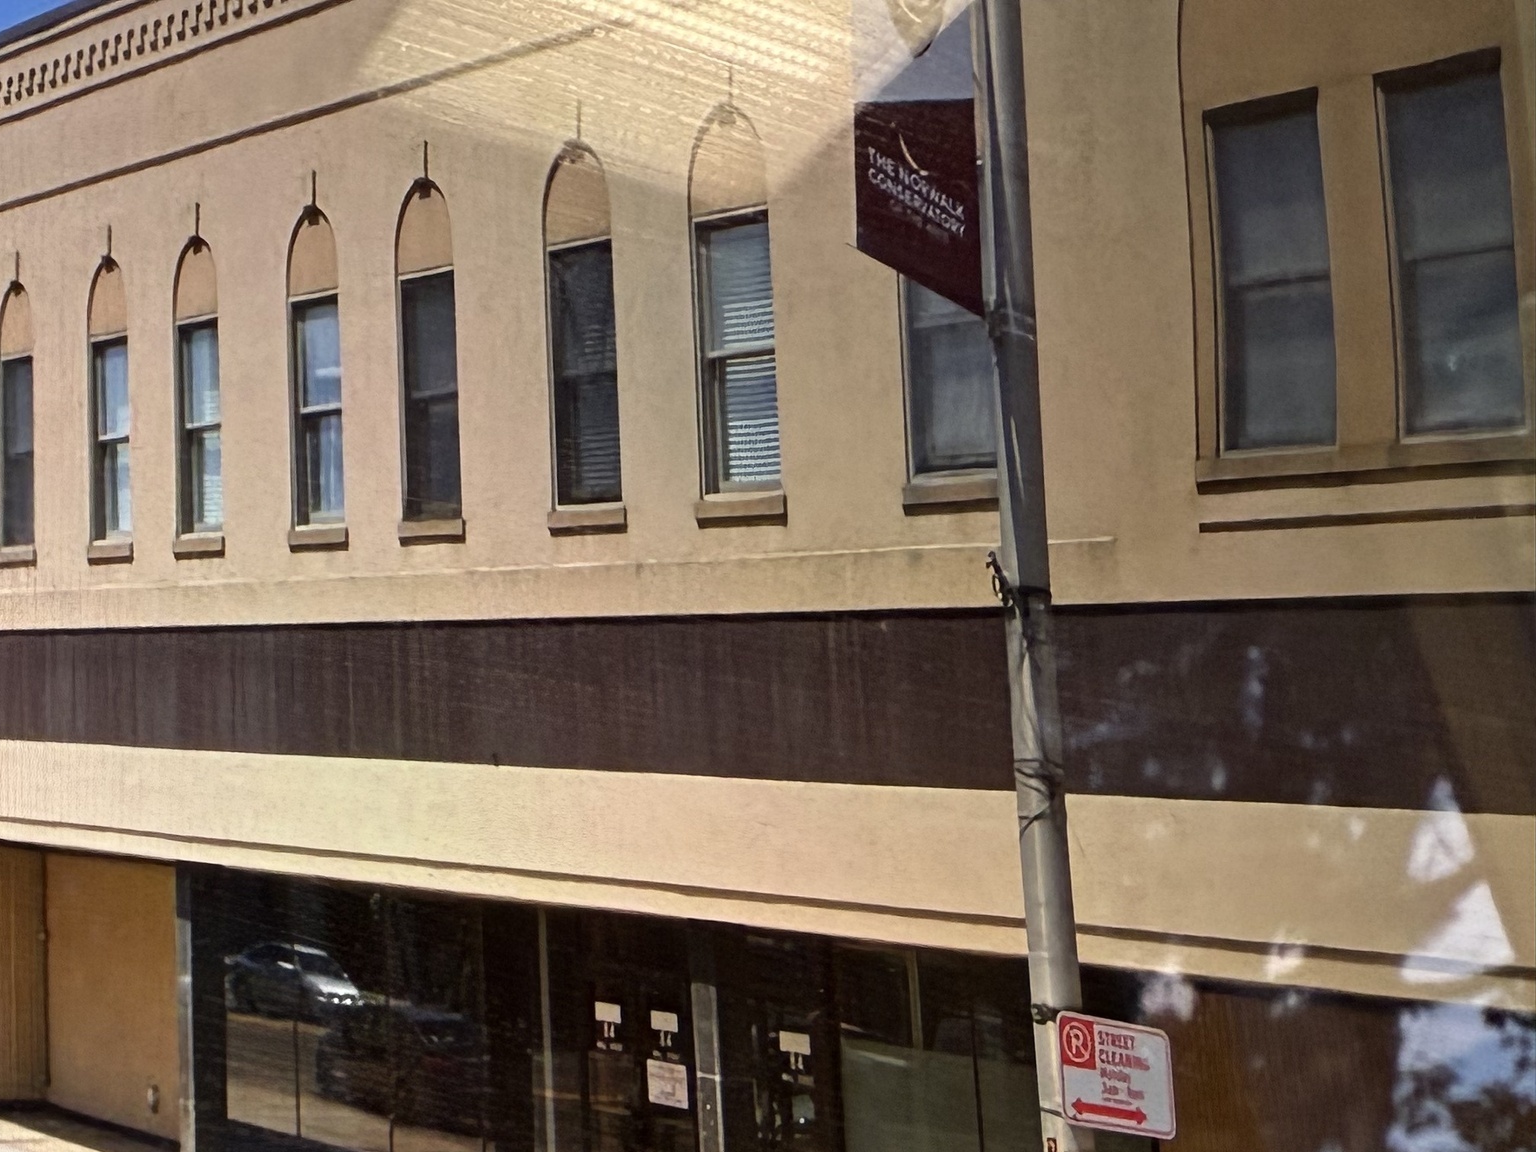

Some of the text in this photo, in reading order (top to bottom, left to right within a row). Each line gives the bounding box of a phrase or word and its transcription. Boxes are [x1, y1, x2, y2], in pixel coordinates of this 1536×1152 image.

[867, 166, 967, 238] CONSERVATORY
[868, 145, 966, 221] THE NORWALK
[1097, 1030, 1135, 1051] STREET
